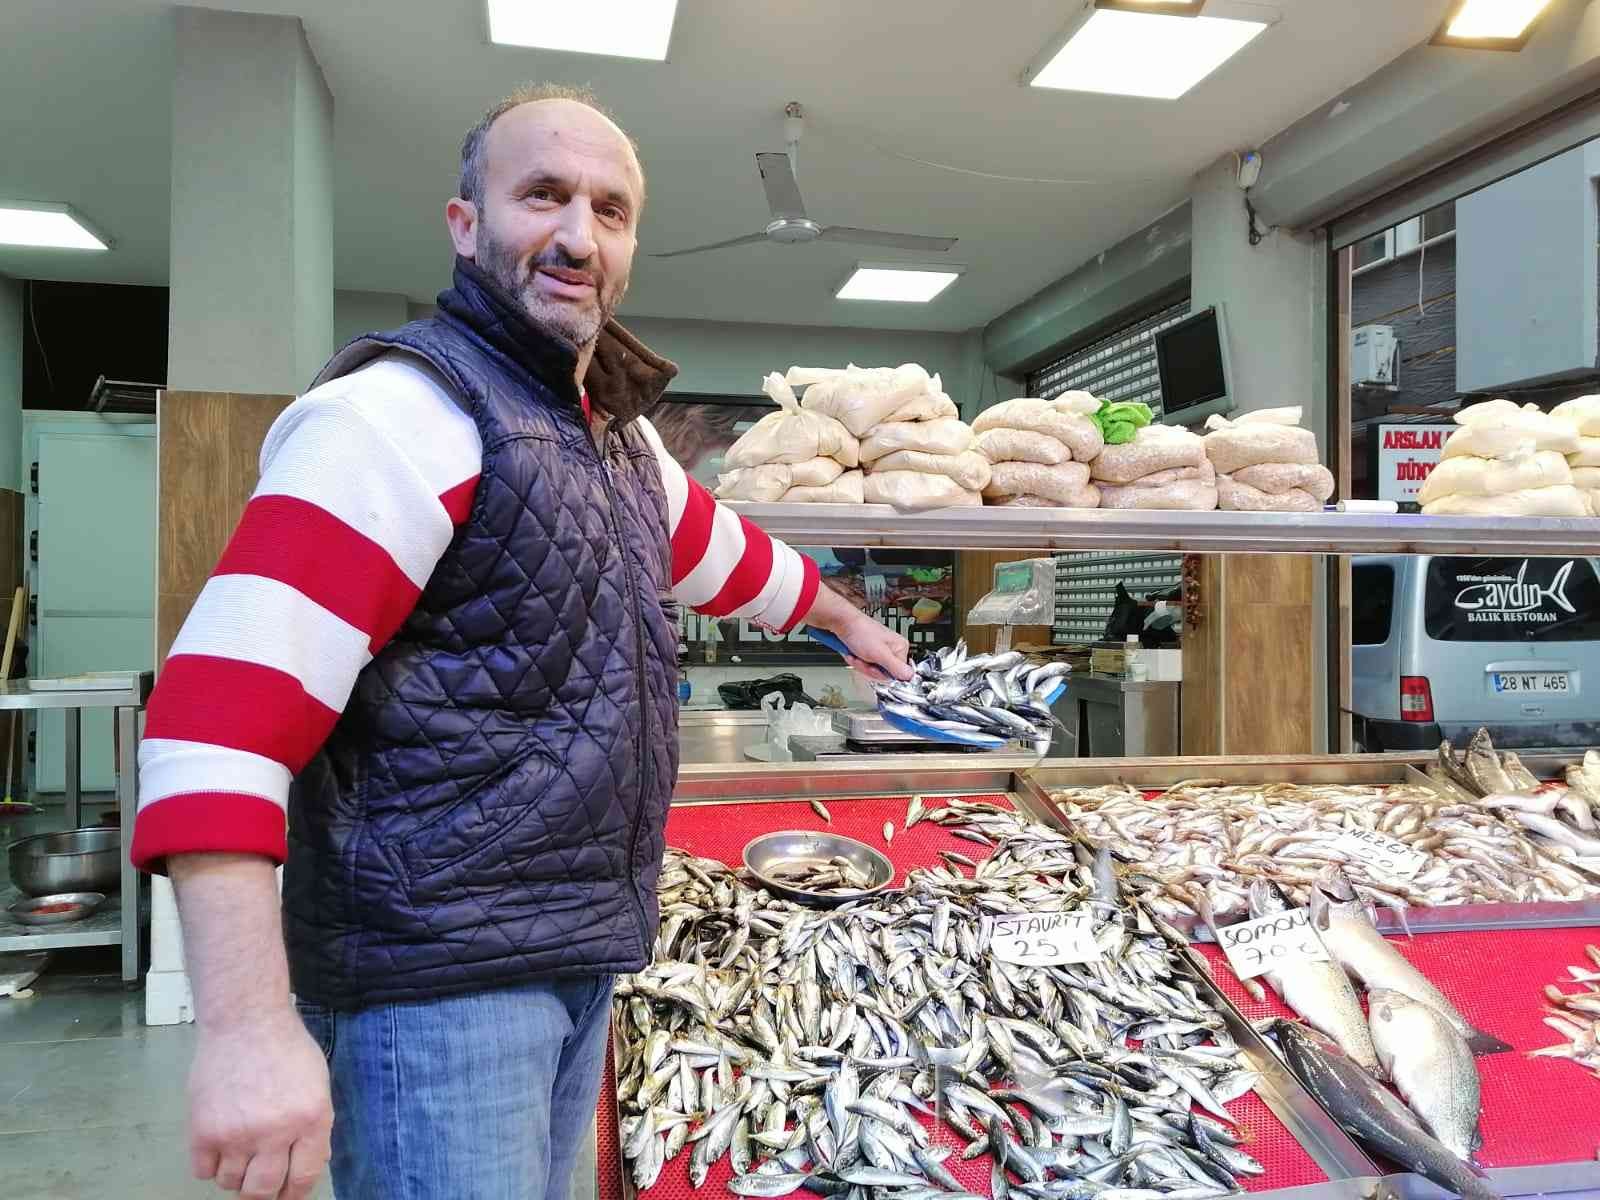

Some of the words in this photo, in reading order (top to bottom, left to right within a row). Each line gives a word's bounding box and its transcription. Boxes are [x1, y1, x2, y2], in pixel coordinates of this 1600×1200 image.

[1383, 431, 1441, 449] ARSLAN
[1467, 612, 1501, 622] BALIK
[1503, 612, 1557, 622] RESTORAN
[1502, 676, 1518, 690] 28
[1522, 676, 1537, 690] NT
[1543, 676, 1567, 690] 465
[1014, 939, 1059, 957] 25
